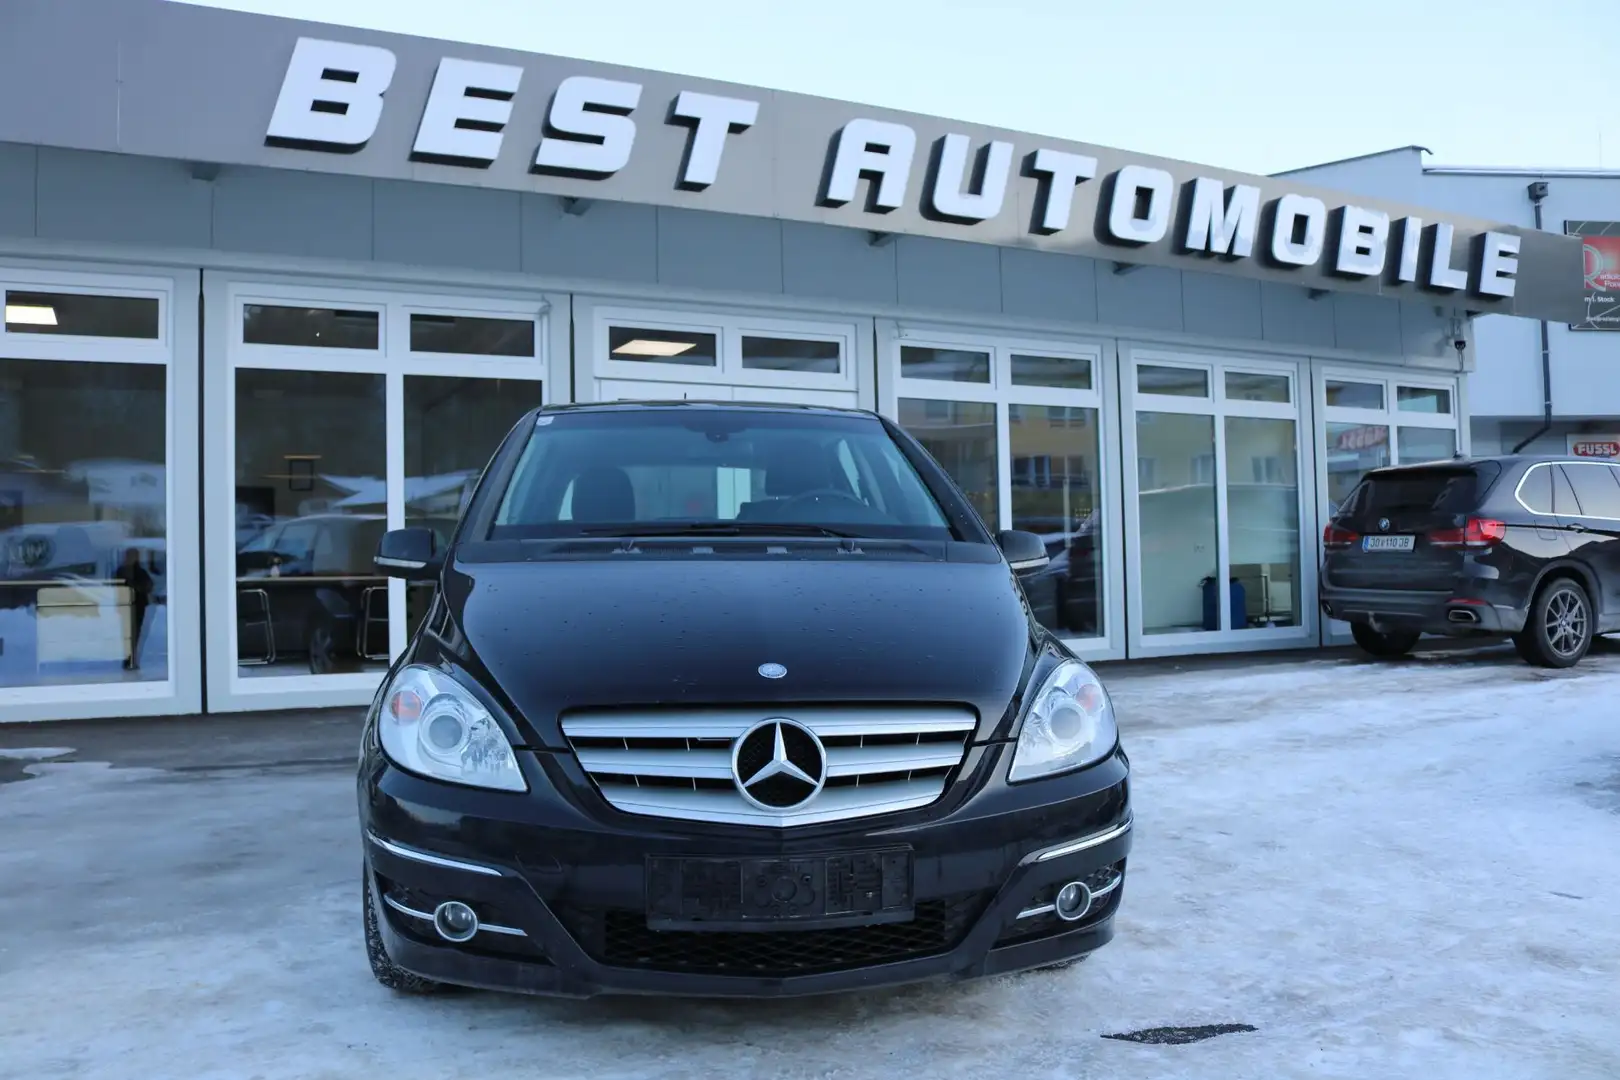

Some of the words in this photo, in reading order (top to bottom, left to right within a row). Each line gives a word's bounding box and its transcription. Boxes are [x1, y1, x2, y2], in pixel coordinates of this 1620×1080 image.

[264, 36, 760, 191] BEST
[816, 117, 1521, 298] AUTOMOBILE
[1578, 443, 1616, 455] FUSSL
